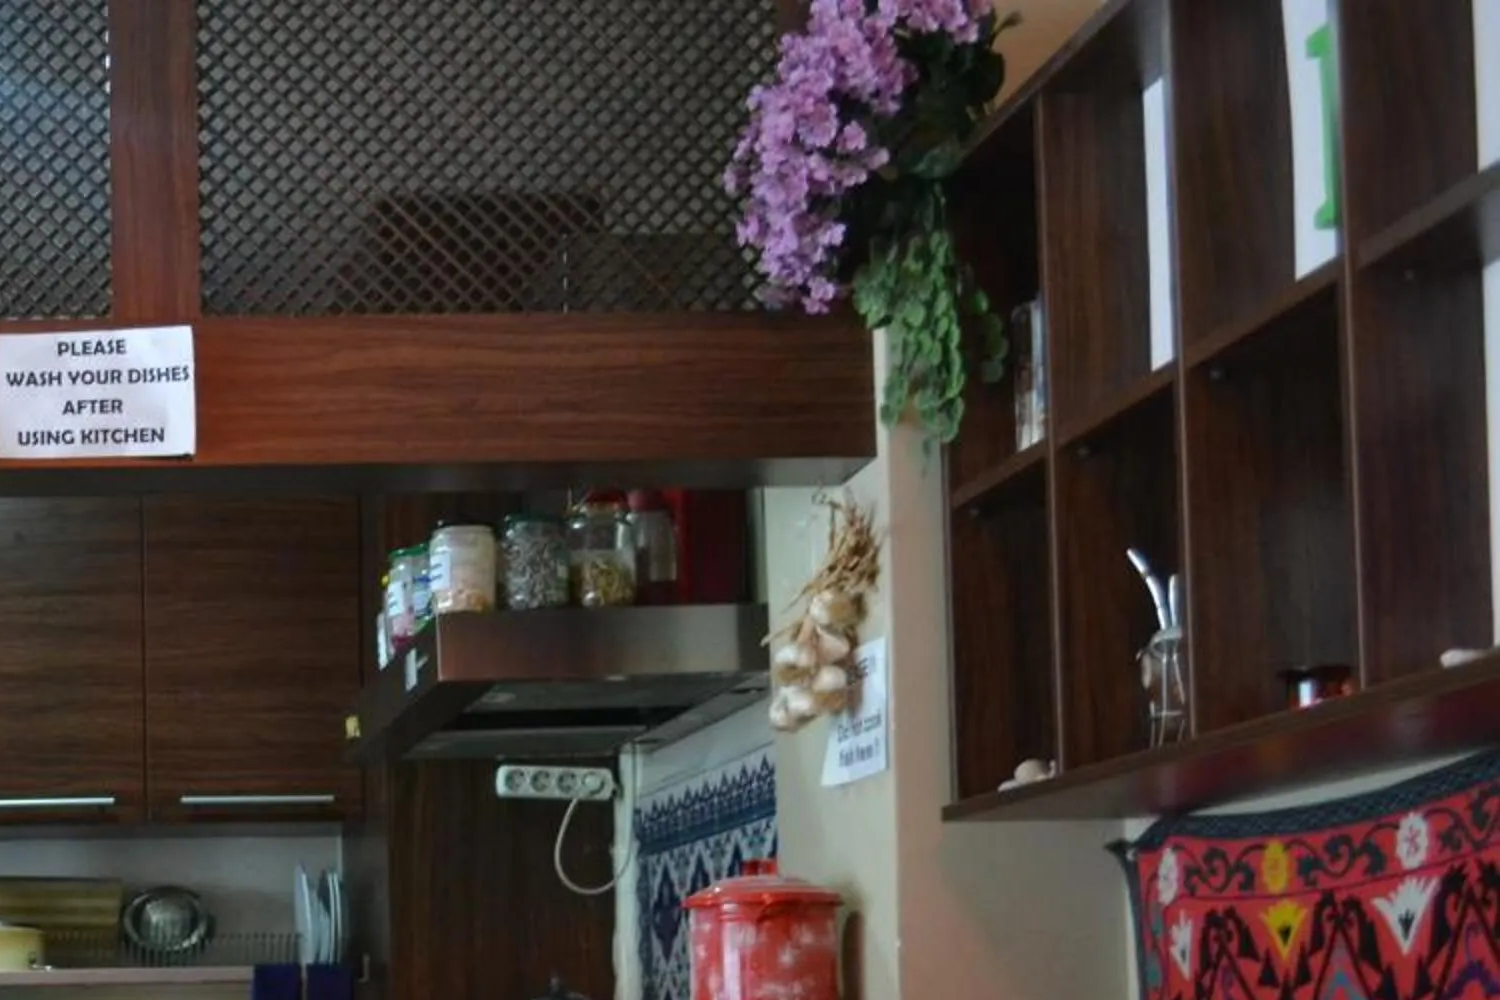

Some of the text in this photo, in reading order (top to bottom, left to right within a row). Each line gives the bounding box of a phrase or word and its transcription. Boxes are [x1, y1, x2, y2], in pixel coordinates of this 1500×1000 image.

[57, 338, 127, 357] PLEASE
[6, 365, 190, 388] WASH YOUR DISHES
[62, 398, 124, 416] AFTER
[17, 427, 166, 447] USING KITCHEN
